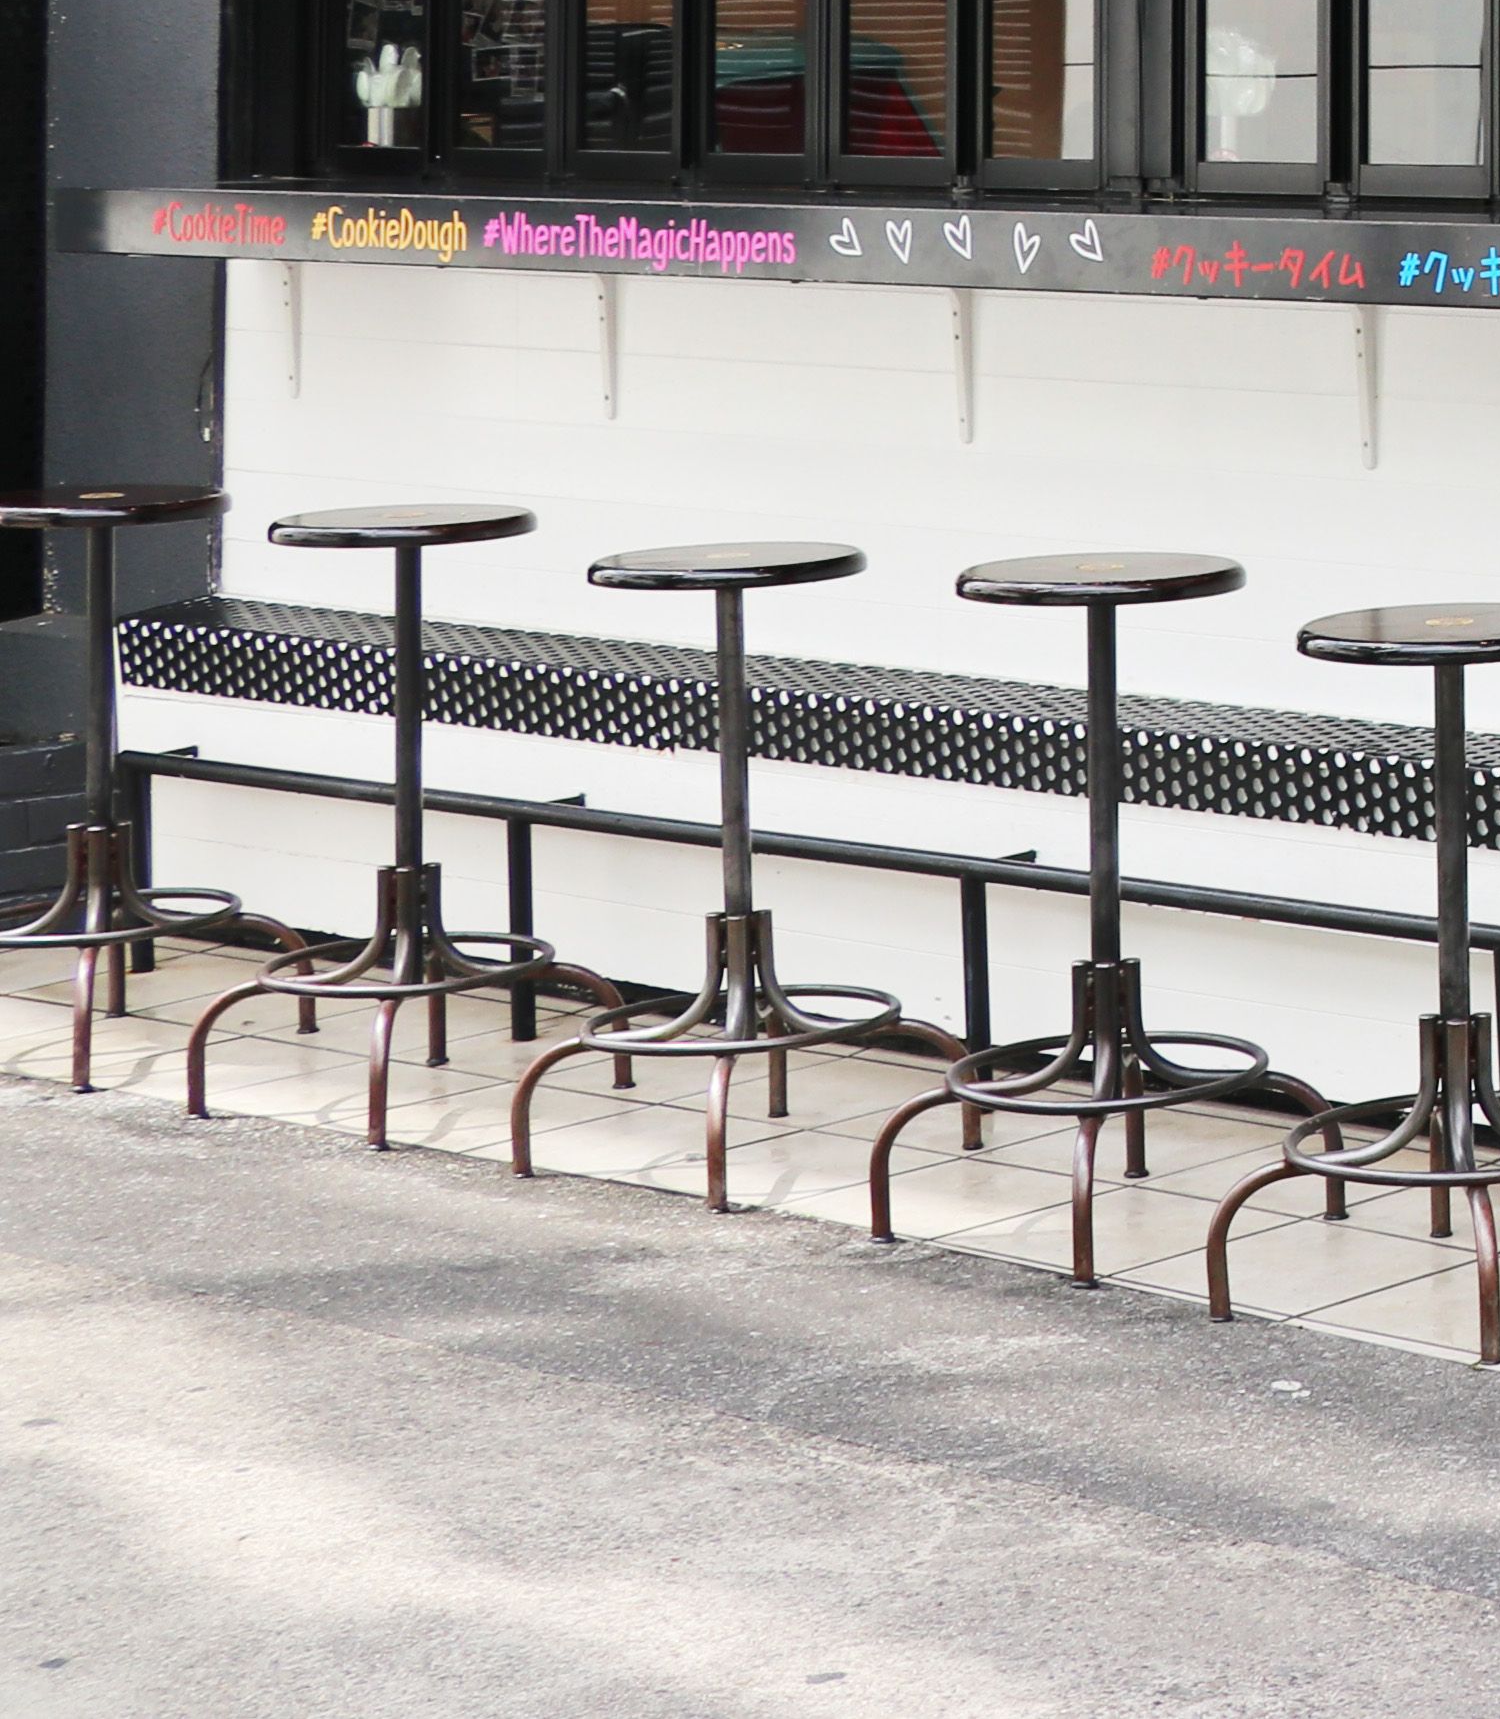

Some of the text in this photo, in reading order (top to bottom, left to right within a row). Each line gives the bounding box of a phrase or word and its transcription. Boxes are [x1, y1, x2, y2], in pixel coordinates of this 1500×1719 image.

[151, 201, 796, 276] #CookieTime #CookieDough #WhereTheMagicHappens
[1150, 242, 1365, 290] #クッキータイム
